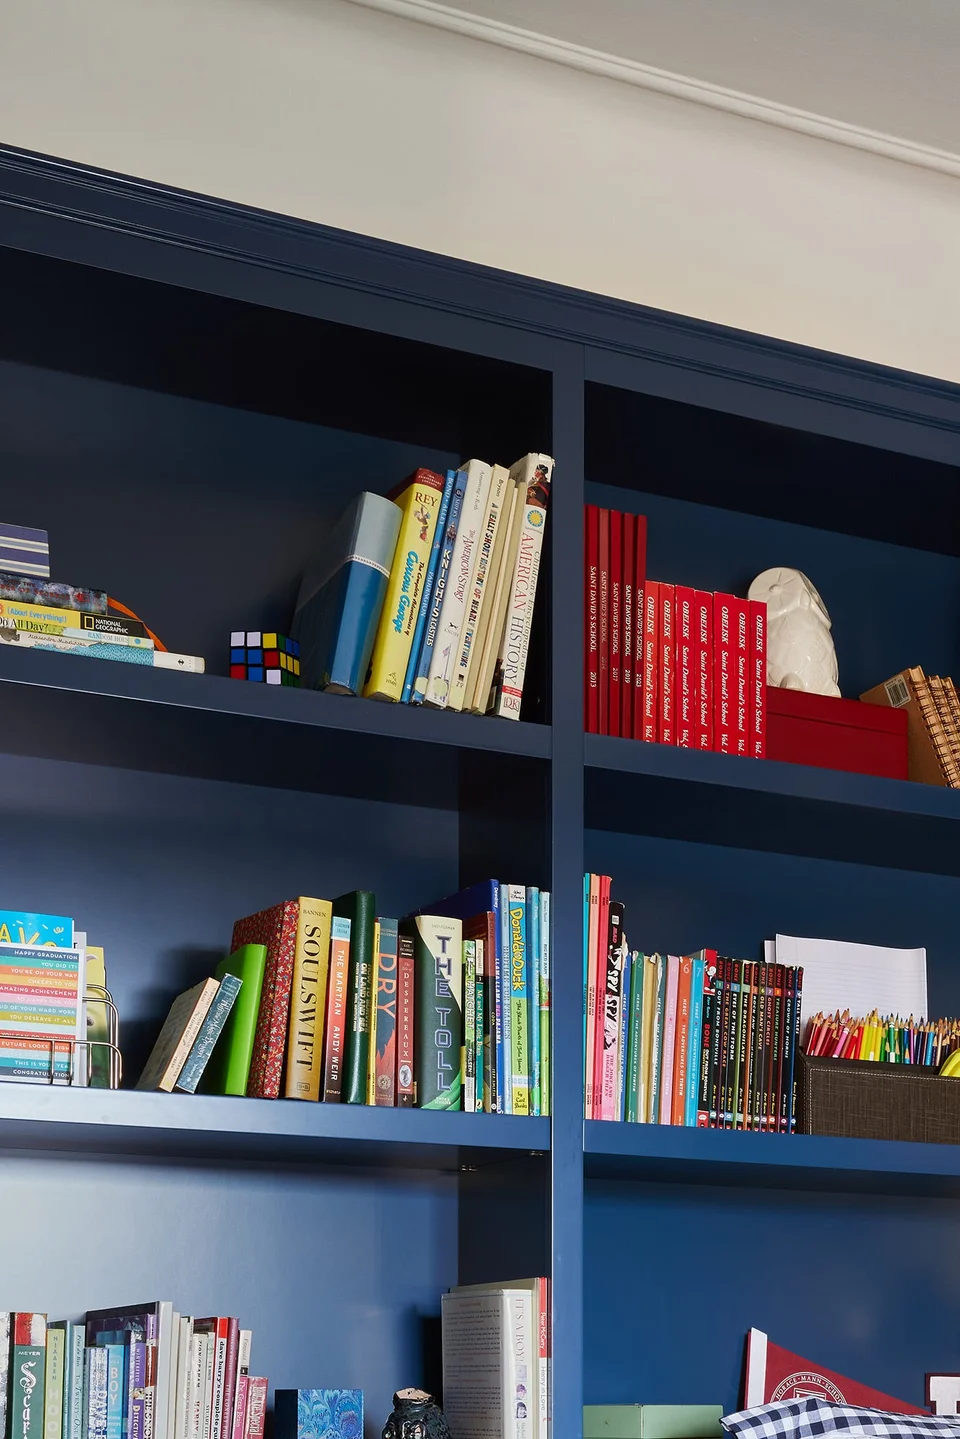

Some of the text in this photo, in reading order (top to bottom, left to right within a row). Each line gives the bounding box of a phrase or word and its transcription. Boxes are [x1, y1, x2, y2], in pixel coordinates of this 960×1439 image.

[415, 491, 438, 507] REY
[393, 551, 419, 634] Curious George
[421, 571, 433, 618] PADDINGTON
[431, 549, 451, 618] KNIGHTS
[454, 535, 475, 603] AMERICAN STORY
[513, 533, 535, 610] AMERICAN
[12, 619, 48, 632] All Day?
[95, 624, 128, 634] GEOGRAPHIC
[96, 619, 121, 627] NATIONAL
[521, 551, 541, 659] Children's Encyclopedia
[504, 616, 525, 686] HISTORY
[303, 909, 327, 917] BANNEN
[37, 952, 78, 960] GRADUATION
[361, 963, 367, 975] ON
[434, 935, 452, 997] THE
[509, 907, 525, 991] Donald Duck
[296, 924, 322, 1071] SOULSWIFT
[378, 952, 397, 1019] DRY
[466, 980, 475, 1029] HATCHET
[606, 970, 618, 1022] SPY SPY
[331, 950, 345, 1081] THE MARTIAN ANDY WEIR
[434, 1007, 452, 1091] TOLL
[110, 1367, 119, 1406] BOY
[776, 1378, 797, 1400] HORACE
